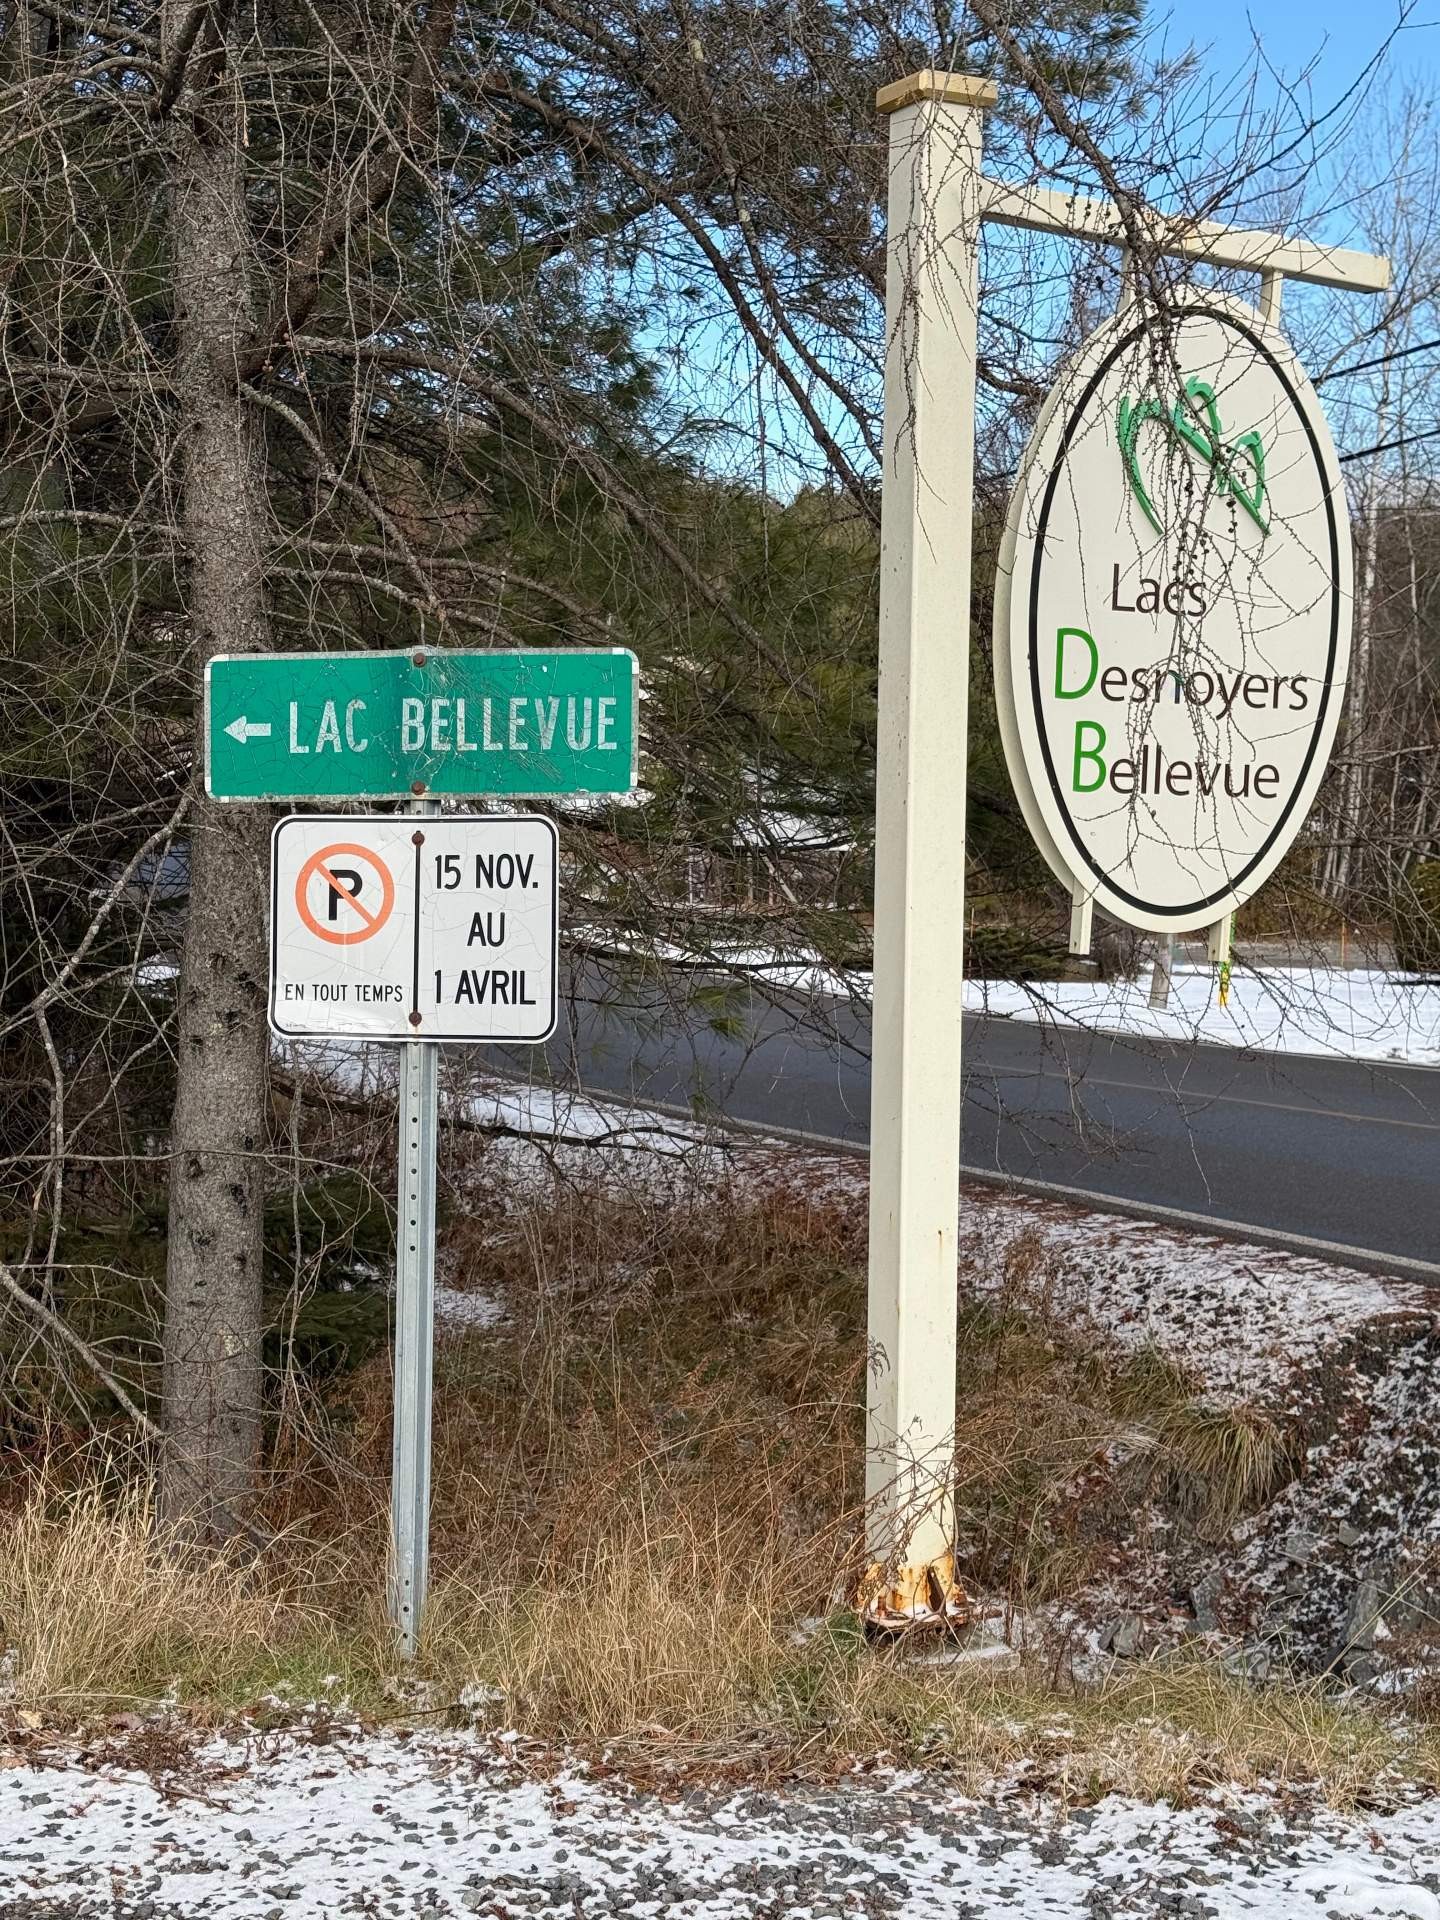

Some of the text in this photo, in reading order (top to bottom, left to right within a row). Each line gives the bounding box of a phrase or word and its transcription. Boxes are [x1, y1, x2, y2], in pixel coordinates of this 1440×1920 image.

[1112, 563, 1207, 617] Lacs
[1054, 627, 1309, 720] Desnoyers
[288, 696, 617, 754] LAC BELLEVUE
[1072, 720, 1280, 799] Bellevue
[328, 869, 363, 921] P
[434, 853, 539, 890] 15 NOV.
[467, 911, 505, 947] AU
[285, 984, 403, 1003] EN TOUT TEMPS
[434, 969, 536, 1006] 1 AVRIL
